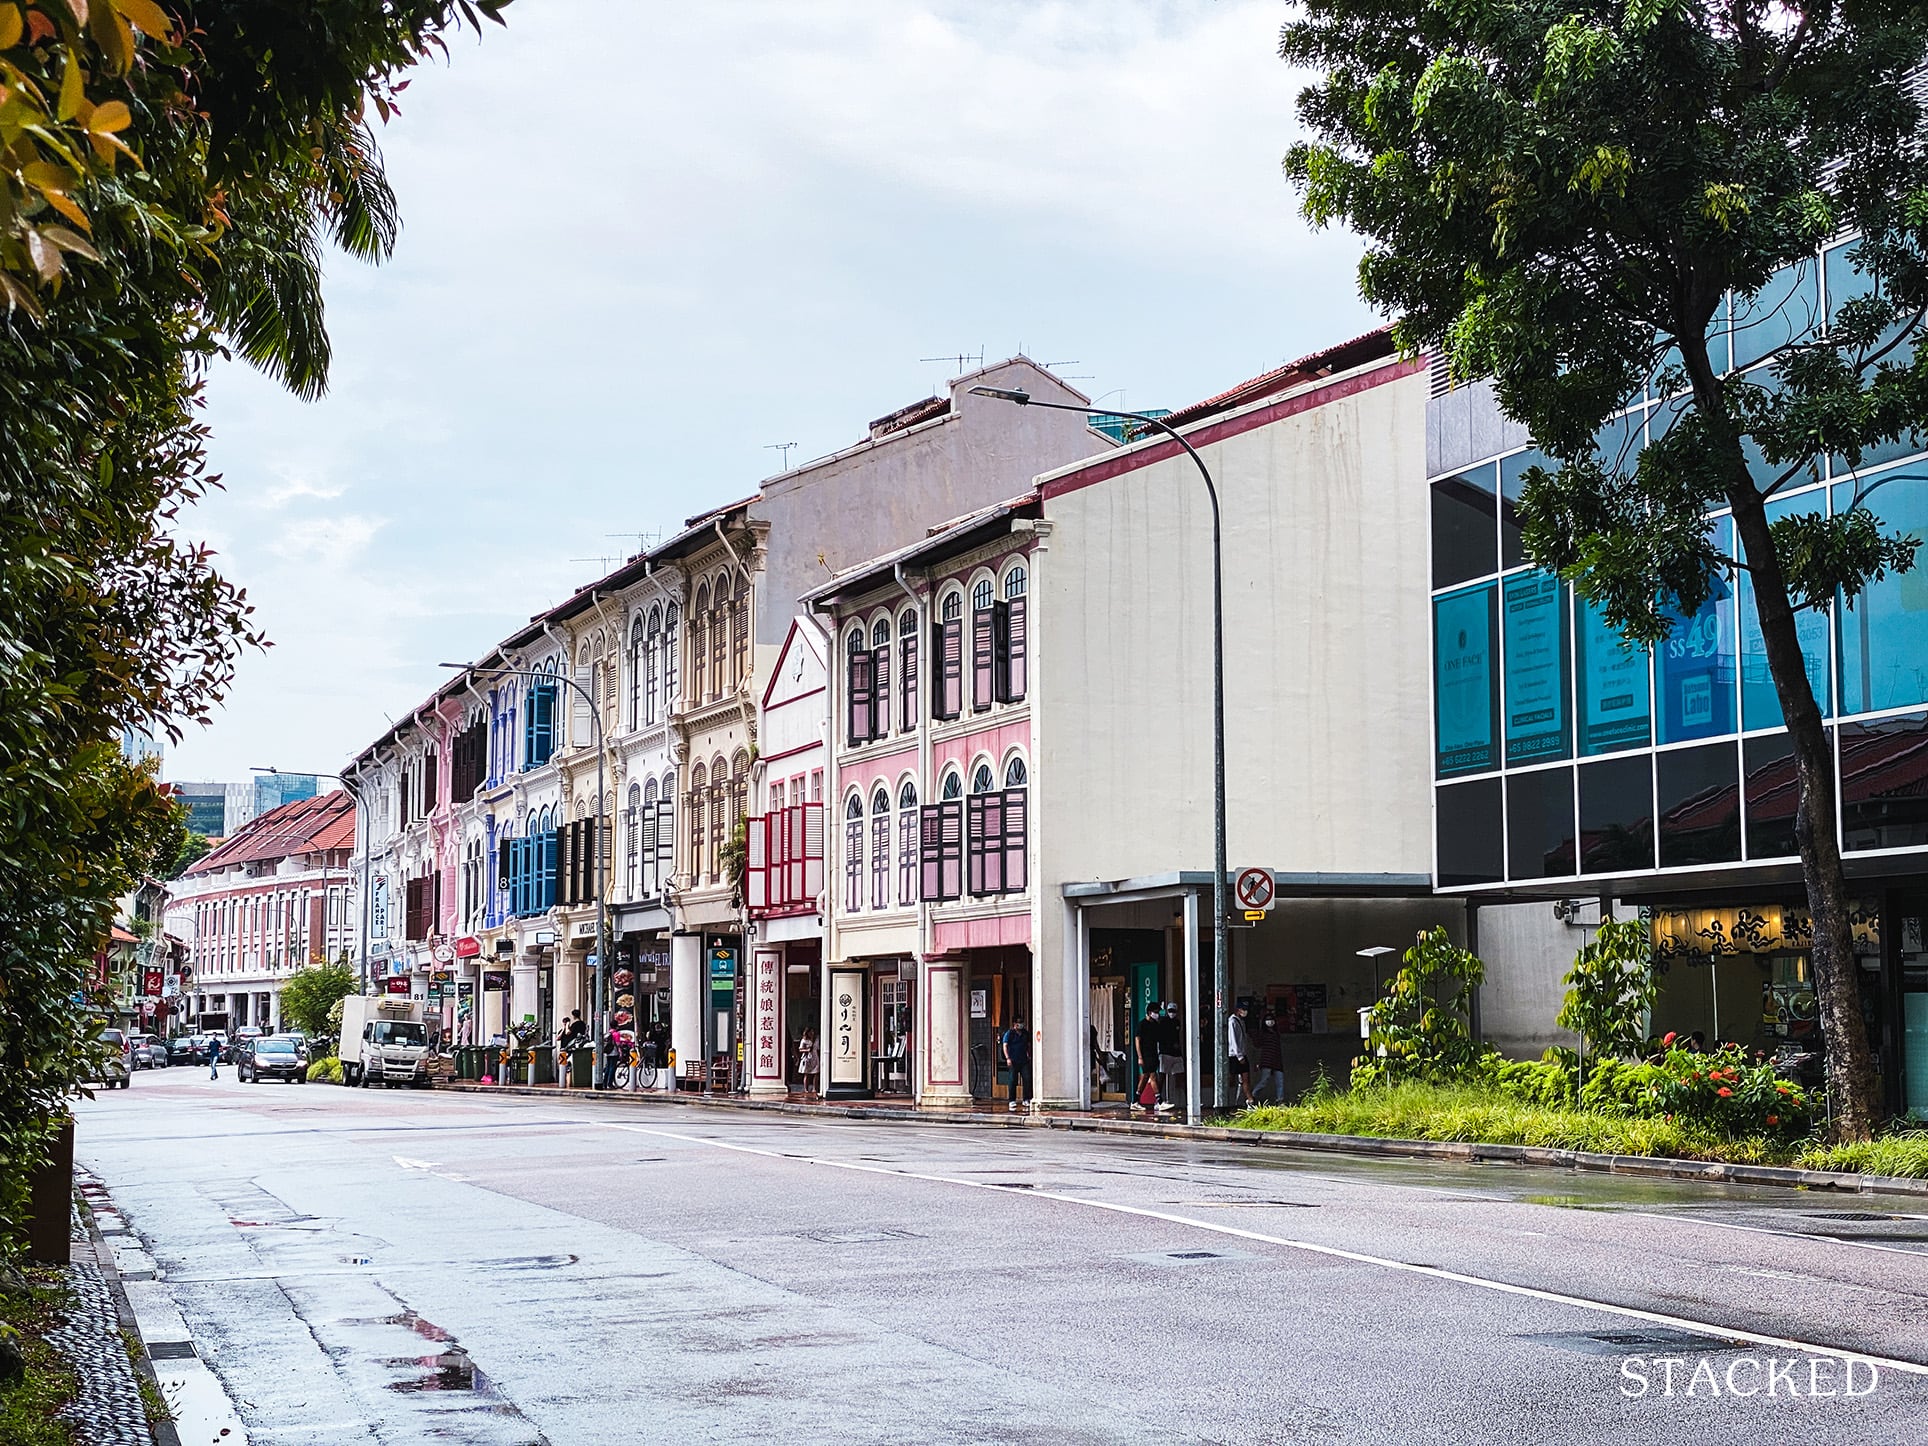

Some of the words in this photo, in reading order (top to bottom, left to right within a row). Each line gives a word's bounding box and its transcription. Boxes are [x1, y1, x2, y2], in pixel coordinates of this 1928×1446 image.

[760, 960, 774, 1069] 傳統娘惹餐館
